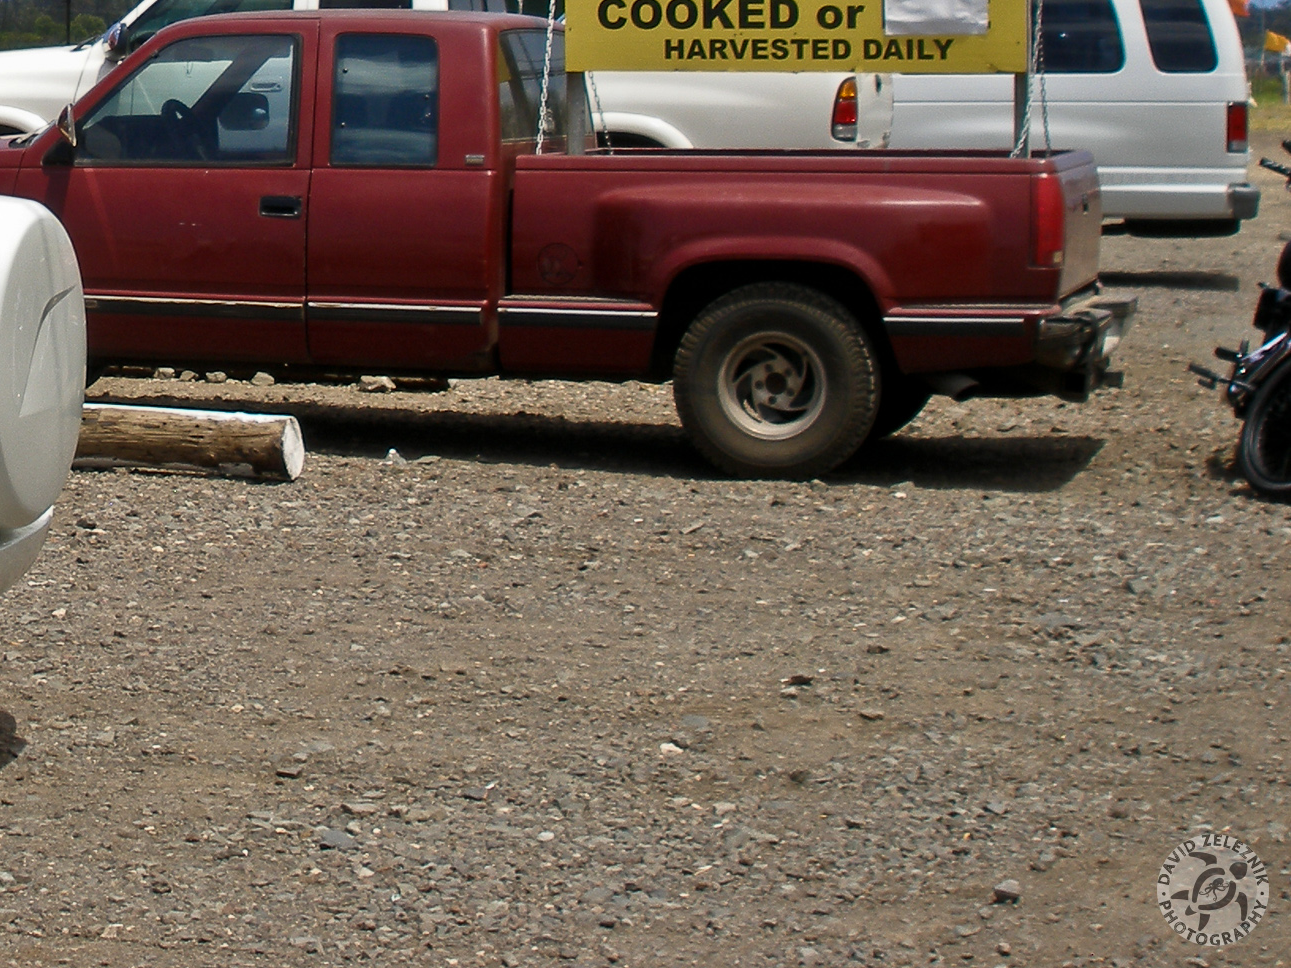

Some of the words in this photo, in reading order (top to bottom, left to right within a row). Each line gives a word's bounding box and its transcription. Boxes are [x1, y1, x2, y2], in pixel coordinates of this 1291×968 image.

[816, 4, 865, 30] or
[664, 38, 851, 60] HARVESTED
[863, 38, 954, 60] DAILY
